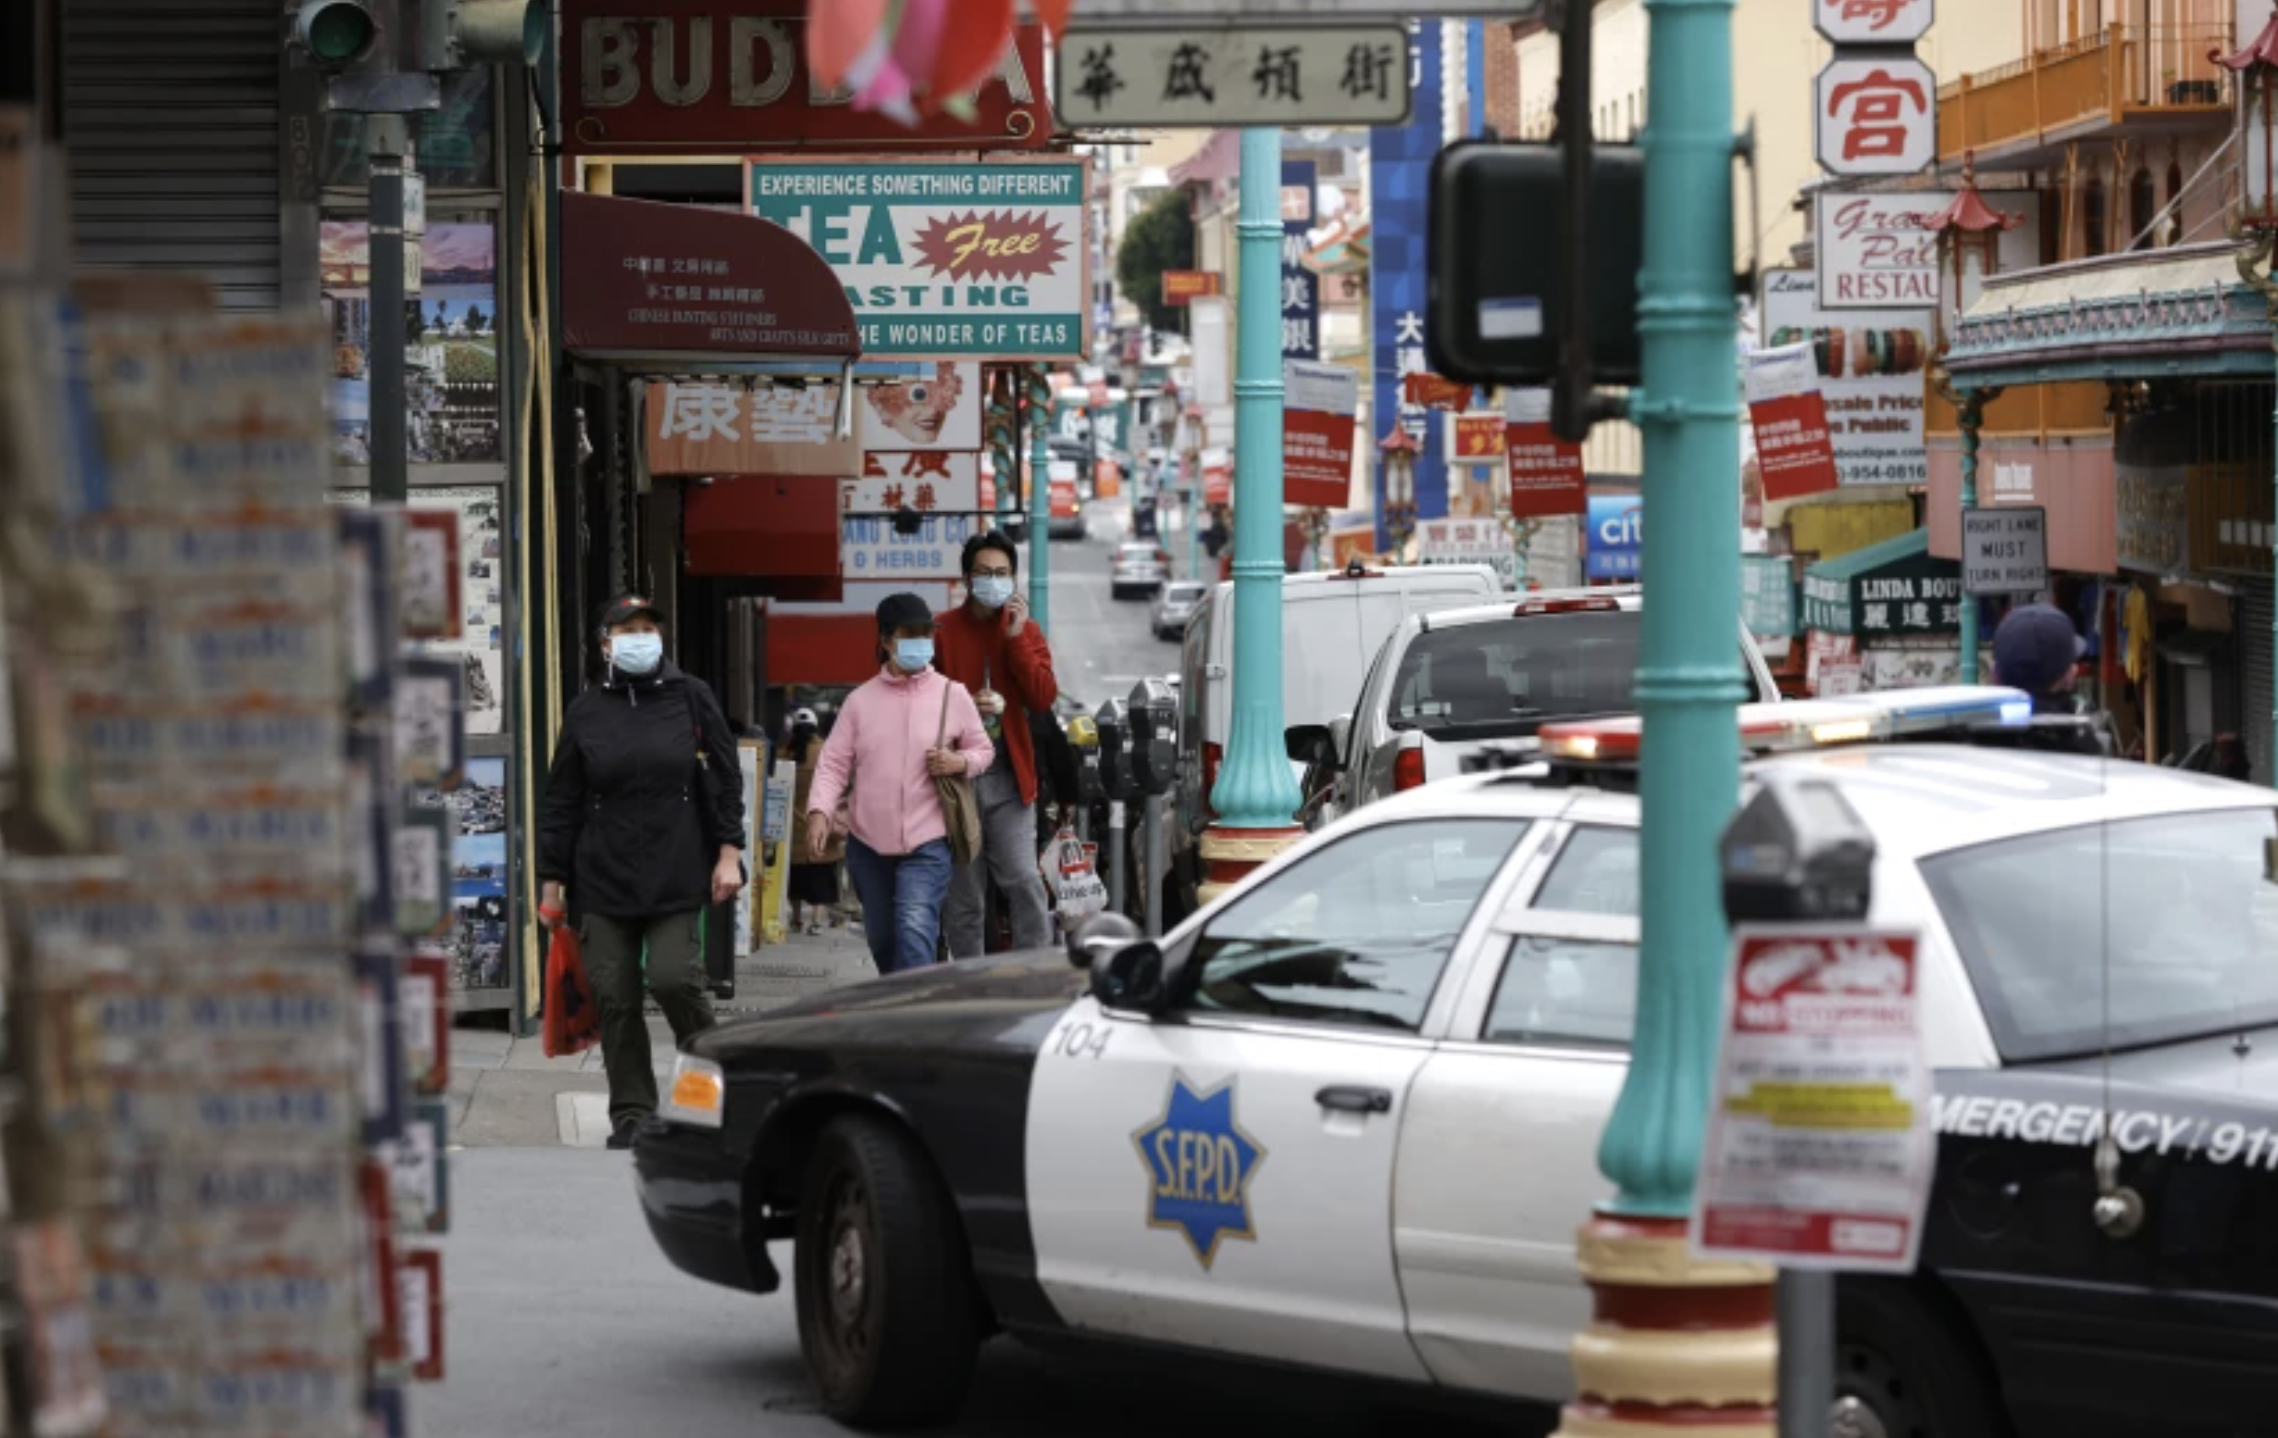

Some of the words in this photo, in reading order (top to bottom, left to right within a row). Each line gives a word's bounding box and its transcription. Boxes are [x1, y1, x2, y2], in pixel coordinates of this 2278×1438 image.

[761, 174, 866, 196] EXPERIENCE
[872, 174, 974, 196] SOMETHING
[978, 174, 1073, 196] DIFFERENT
[945, 222, 1043, 268] Free
[889, 325, 974, 345] WONDER
[982, 325, 1006, 345] OF
[1017, 325, 1067, 344] TEAS
[1967, 518, 2001, 534] RIGHT
[2008, 517, 2040, 532] LANE
[876, 549, 943, 569] HERBS
[1981, 541, 2026, 558] MUST
[1862, 579, 1915, 600] LINDA
[1055, 1023, 1113, 1060] 104
